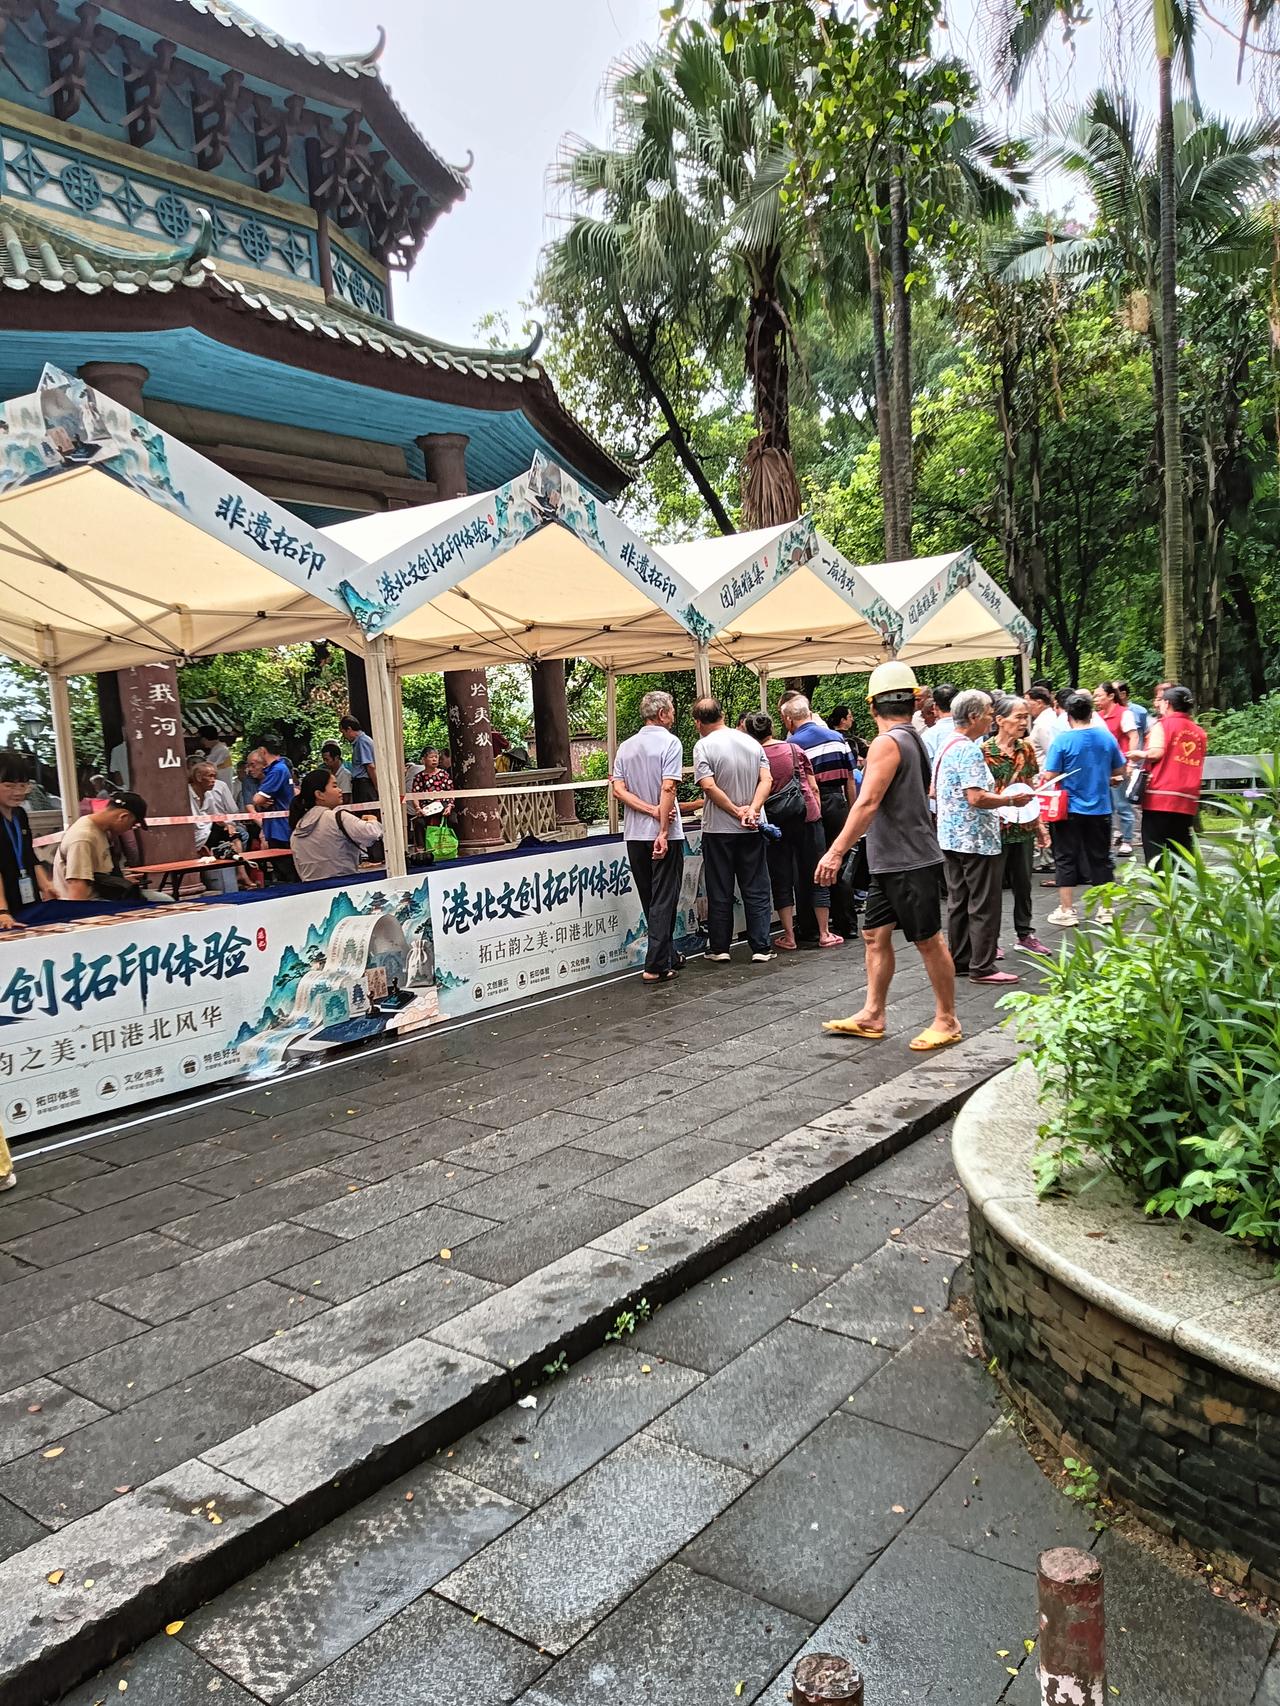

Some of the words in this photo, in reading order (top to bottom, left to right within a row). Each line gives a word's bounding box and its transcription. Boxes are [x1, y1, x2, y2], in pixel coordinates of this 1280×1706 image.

[215, 494, 327, 580] 非遗拓印
[378, 516, 492, 605] 港北文创拓印体验
[619, 542, 677, 604] 非遗拓印
[719, 560, 765, 609] 团扇雅集
[821, 557, 857, 598] 一扇清欢
[145, 662, 181, 769] 我河山
[441, 856, 633, 935] 港北文创拓印体验
[478, 915, 620, 963] 拓古韵之美·印港北风华
[0, 925, 253, 1024] 创拓印体验
[36, 1087, 81, 1108] 拓印体验
